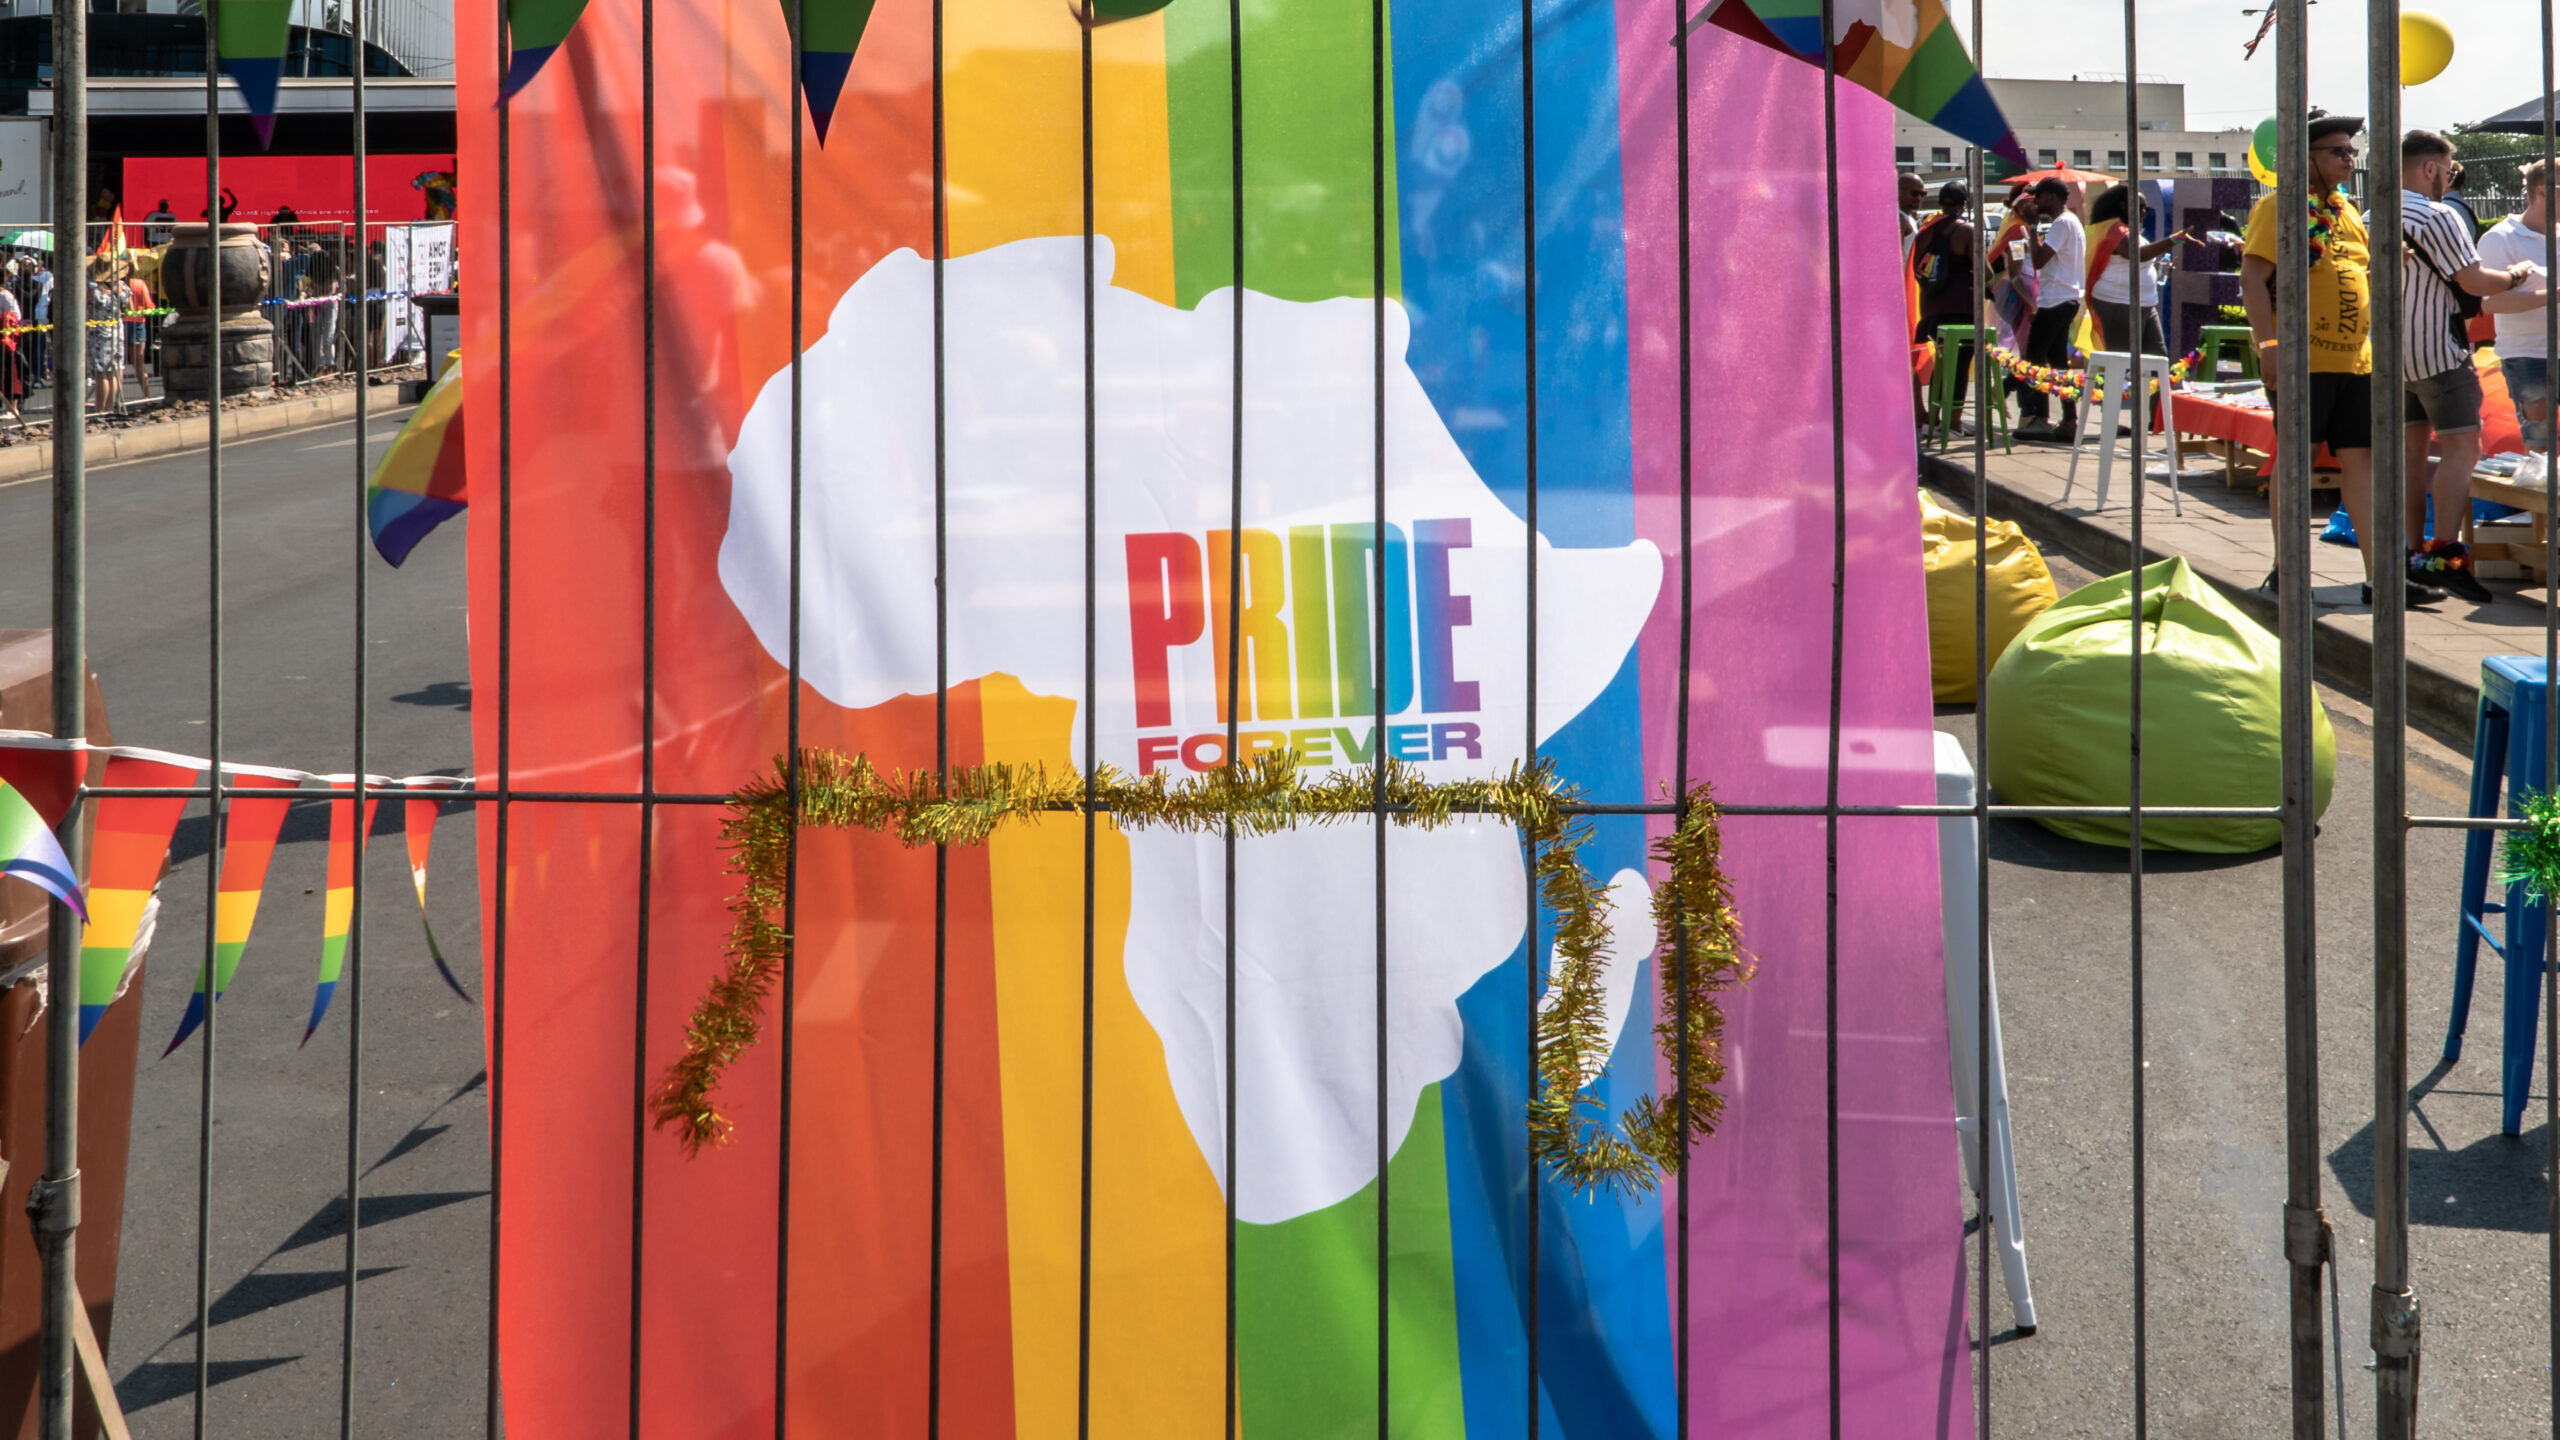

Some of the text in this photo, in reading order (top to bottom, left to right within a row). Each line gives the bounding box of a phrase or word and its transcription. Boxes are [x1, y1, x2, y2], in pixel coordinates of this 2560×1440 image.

[2337, 290, 2359, 335] DAYZ
[1124, 517, 1481, 729] PRIDE
[1136, 722, 1483, 776] FOREVER
